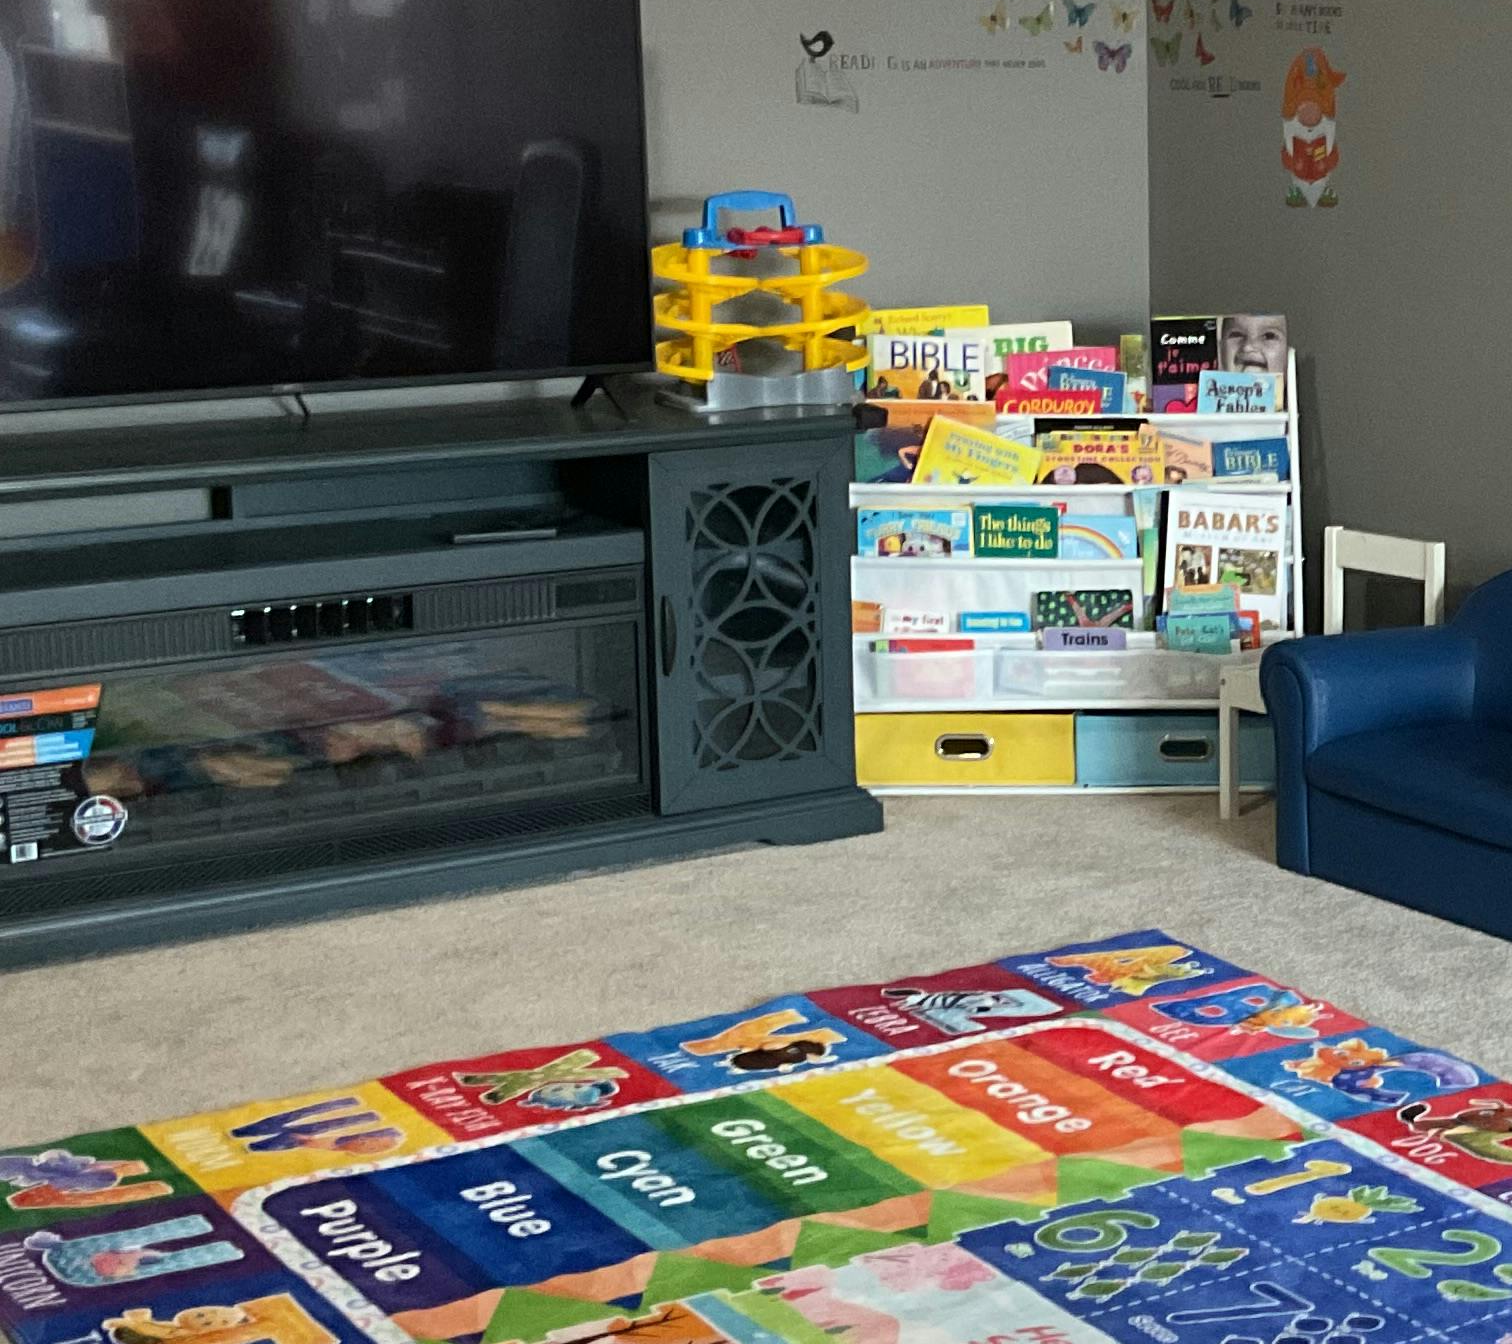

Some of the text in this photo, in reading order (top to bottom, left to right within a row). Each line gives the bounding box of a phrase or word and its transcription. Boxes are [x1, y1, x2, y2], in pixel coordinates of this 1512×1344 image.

[889, 340, 980, 373] BIBLE
[993, 335, 1050, 357] BIG
[1160, 333, 1206, 345] Comme
[1002, 398, 1097, 415] CORDUROY
[1072, 443, 1129, 454] DORA'S
[979, 514, 1004, 531] The
[1008, 513, 1051, 535] things
[1177, 510, 1280, 535] BABAR'S
[987, 533, 1015, 549] like
[1018, 535, 1032, 550] to
[1035, 535, 1053, 550] do
[1060, 631, 1109, 646] Trains
[1016, 962, 1112, 1002] ALLIGATOR
[847, 1005, 920, 1038] ZEBRA
[1149, 1023, 1200, 1044] BEE
[646, 1051, 702, 1075] YAK
[1087, 1049, 1186, 1089] Red
[406, 1075, 503, 1132] X-RAY FISH
[948, 1060, 1092, 1135] Orange
[839, 1088, 966, 1157] Yellow
[710, 1118, 828, 1186] Green
[1390, 1129, 1461, 1165] DOG
[595, 1149, 696, 1209] Cyan
[1244, 1159, 1353, 1196] 1
[458, 1180, 551, 1239] Blue
[301, 1199, 421, 1285] Purple
[1033, 1210, 1161, 1254] 6
[1367, 1229, 1503, 1280] 2
[1165, 1279, 1316, 1326] 7
